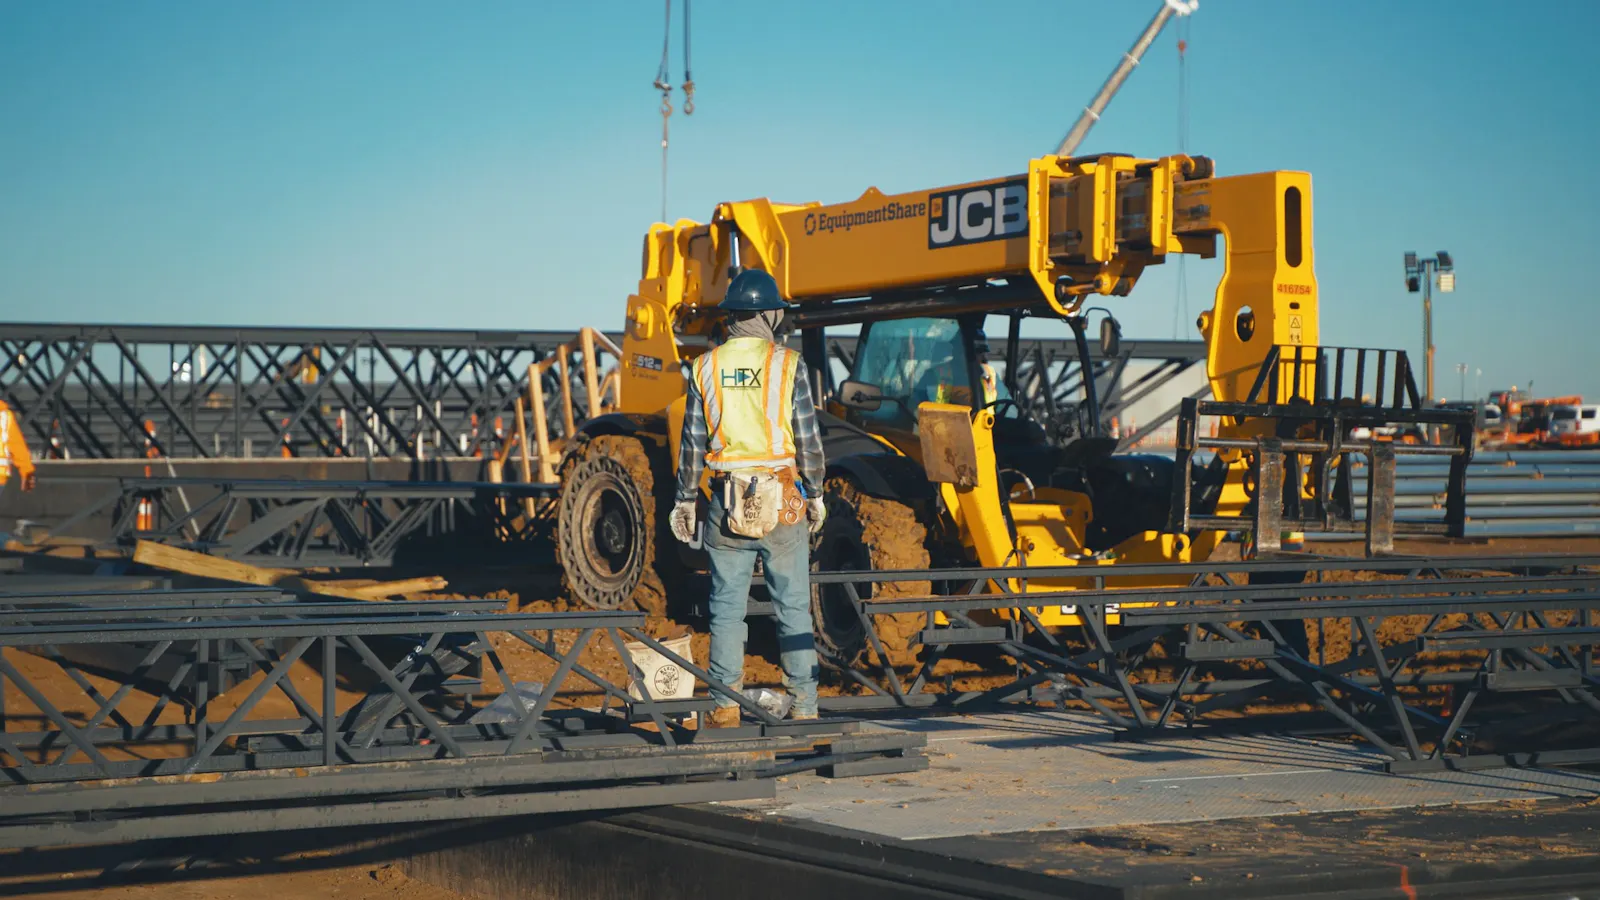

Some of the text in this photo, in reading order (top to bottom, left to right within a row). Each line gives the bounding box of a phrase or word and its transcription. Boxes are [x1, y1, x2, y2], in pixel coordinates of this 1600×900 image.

[819, 201, 926, 234] EquipmentShare
[930, 184, 1028, 244] JCB
[1277, 283, 1311, 295] 416754
[721, 367, 762, 387] HTX
